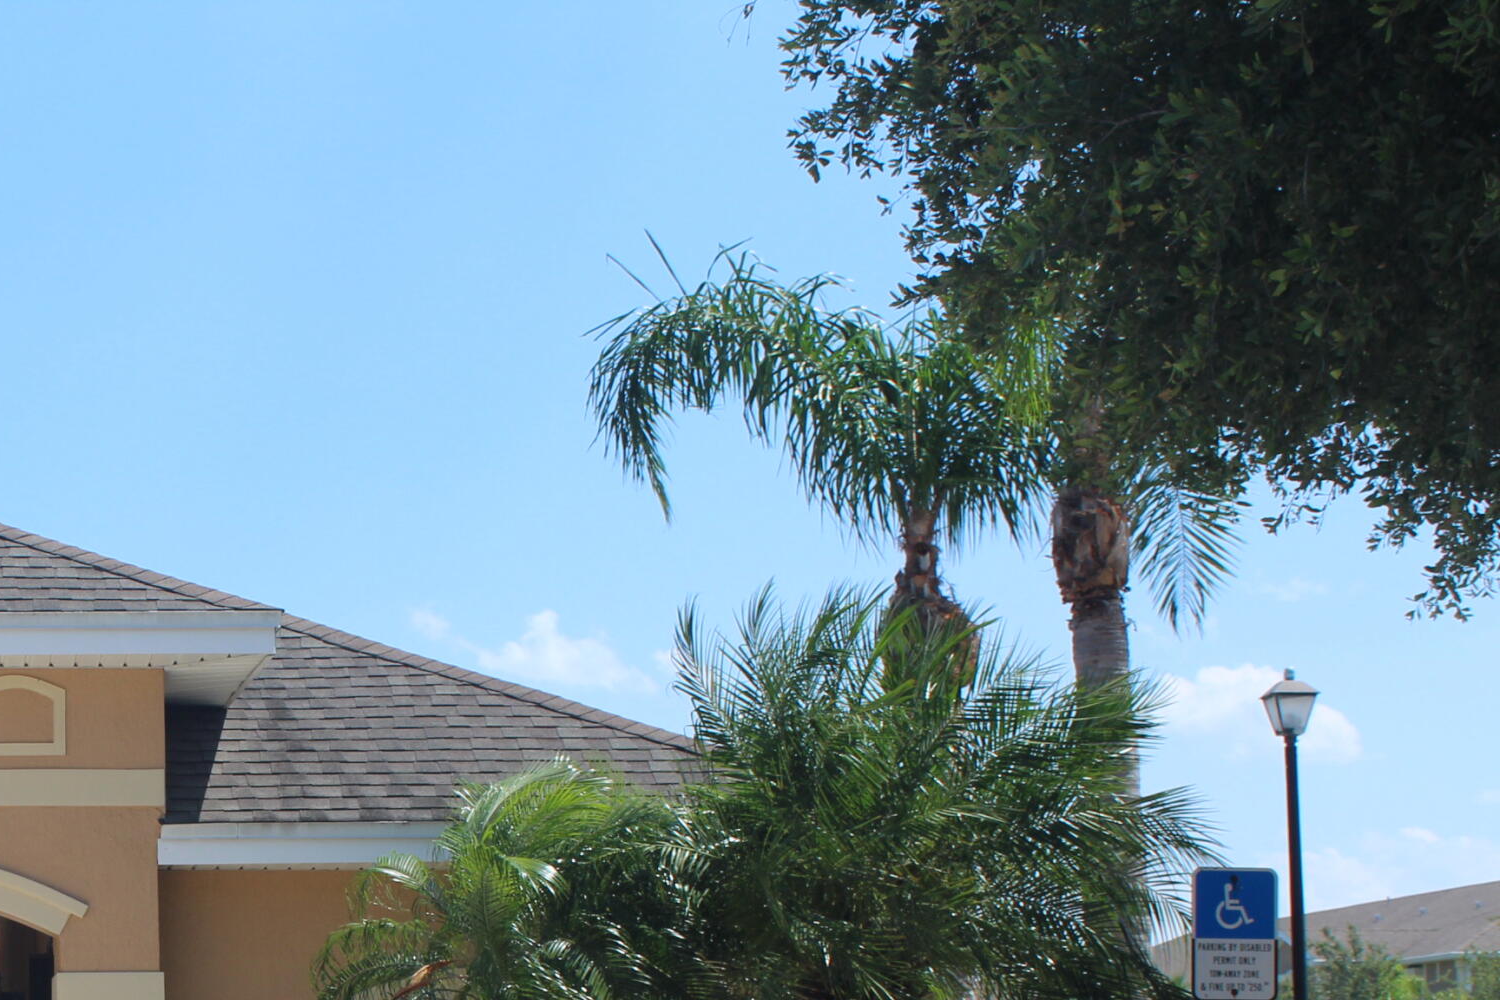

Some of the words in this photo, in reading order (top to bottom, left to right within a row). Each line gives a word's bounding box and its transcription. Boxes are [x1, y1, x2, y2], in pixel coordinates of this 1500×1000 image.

[1198, 943, 1226, 952] PARKING
[1228, 943, 1237, 952] BY
[1240, 943, 1271, 952] DISABLED
[1213, 956, 1236, 964] PERMIT
[1239, 956, 1256, 964] ONLY
[1209, 983, 1223, 991] FINE
[1237, 983, 1245, 991] TO
